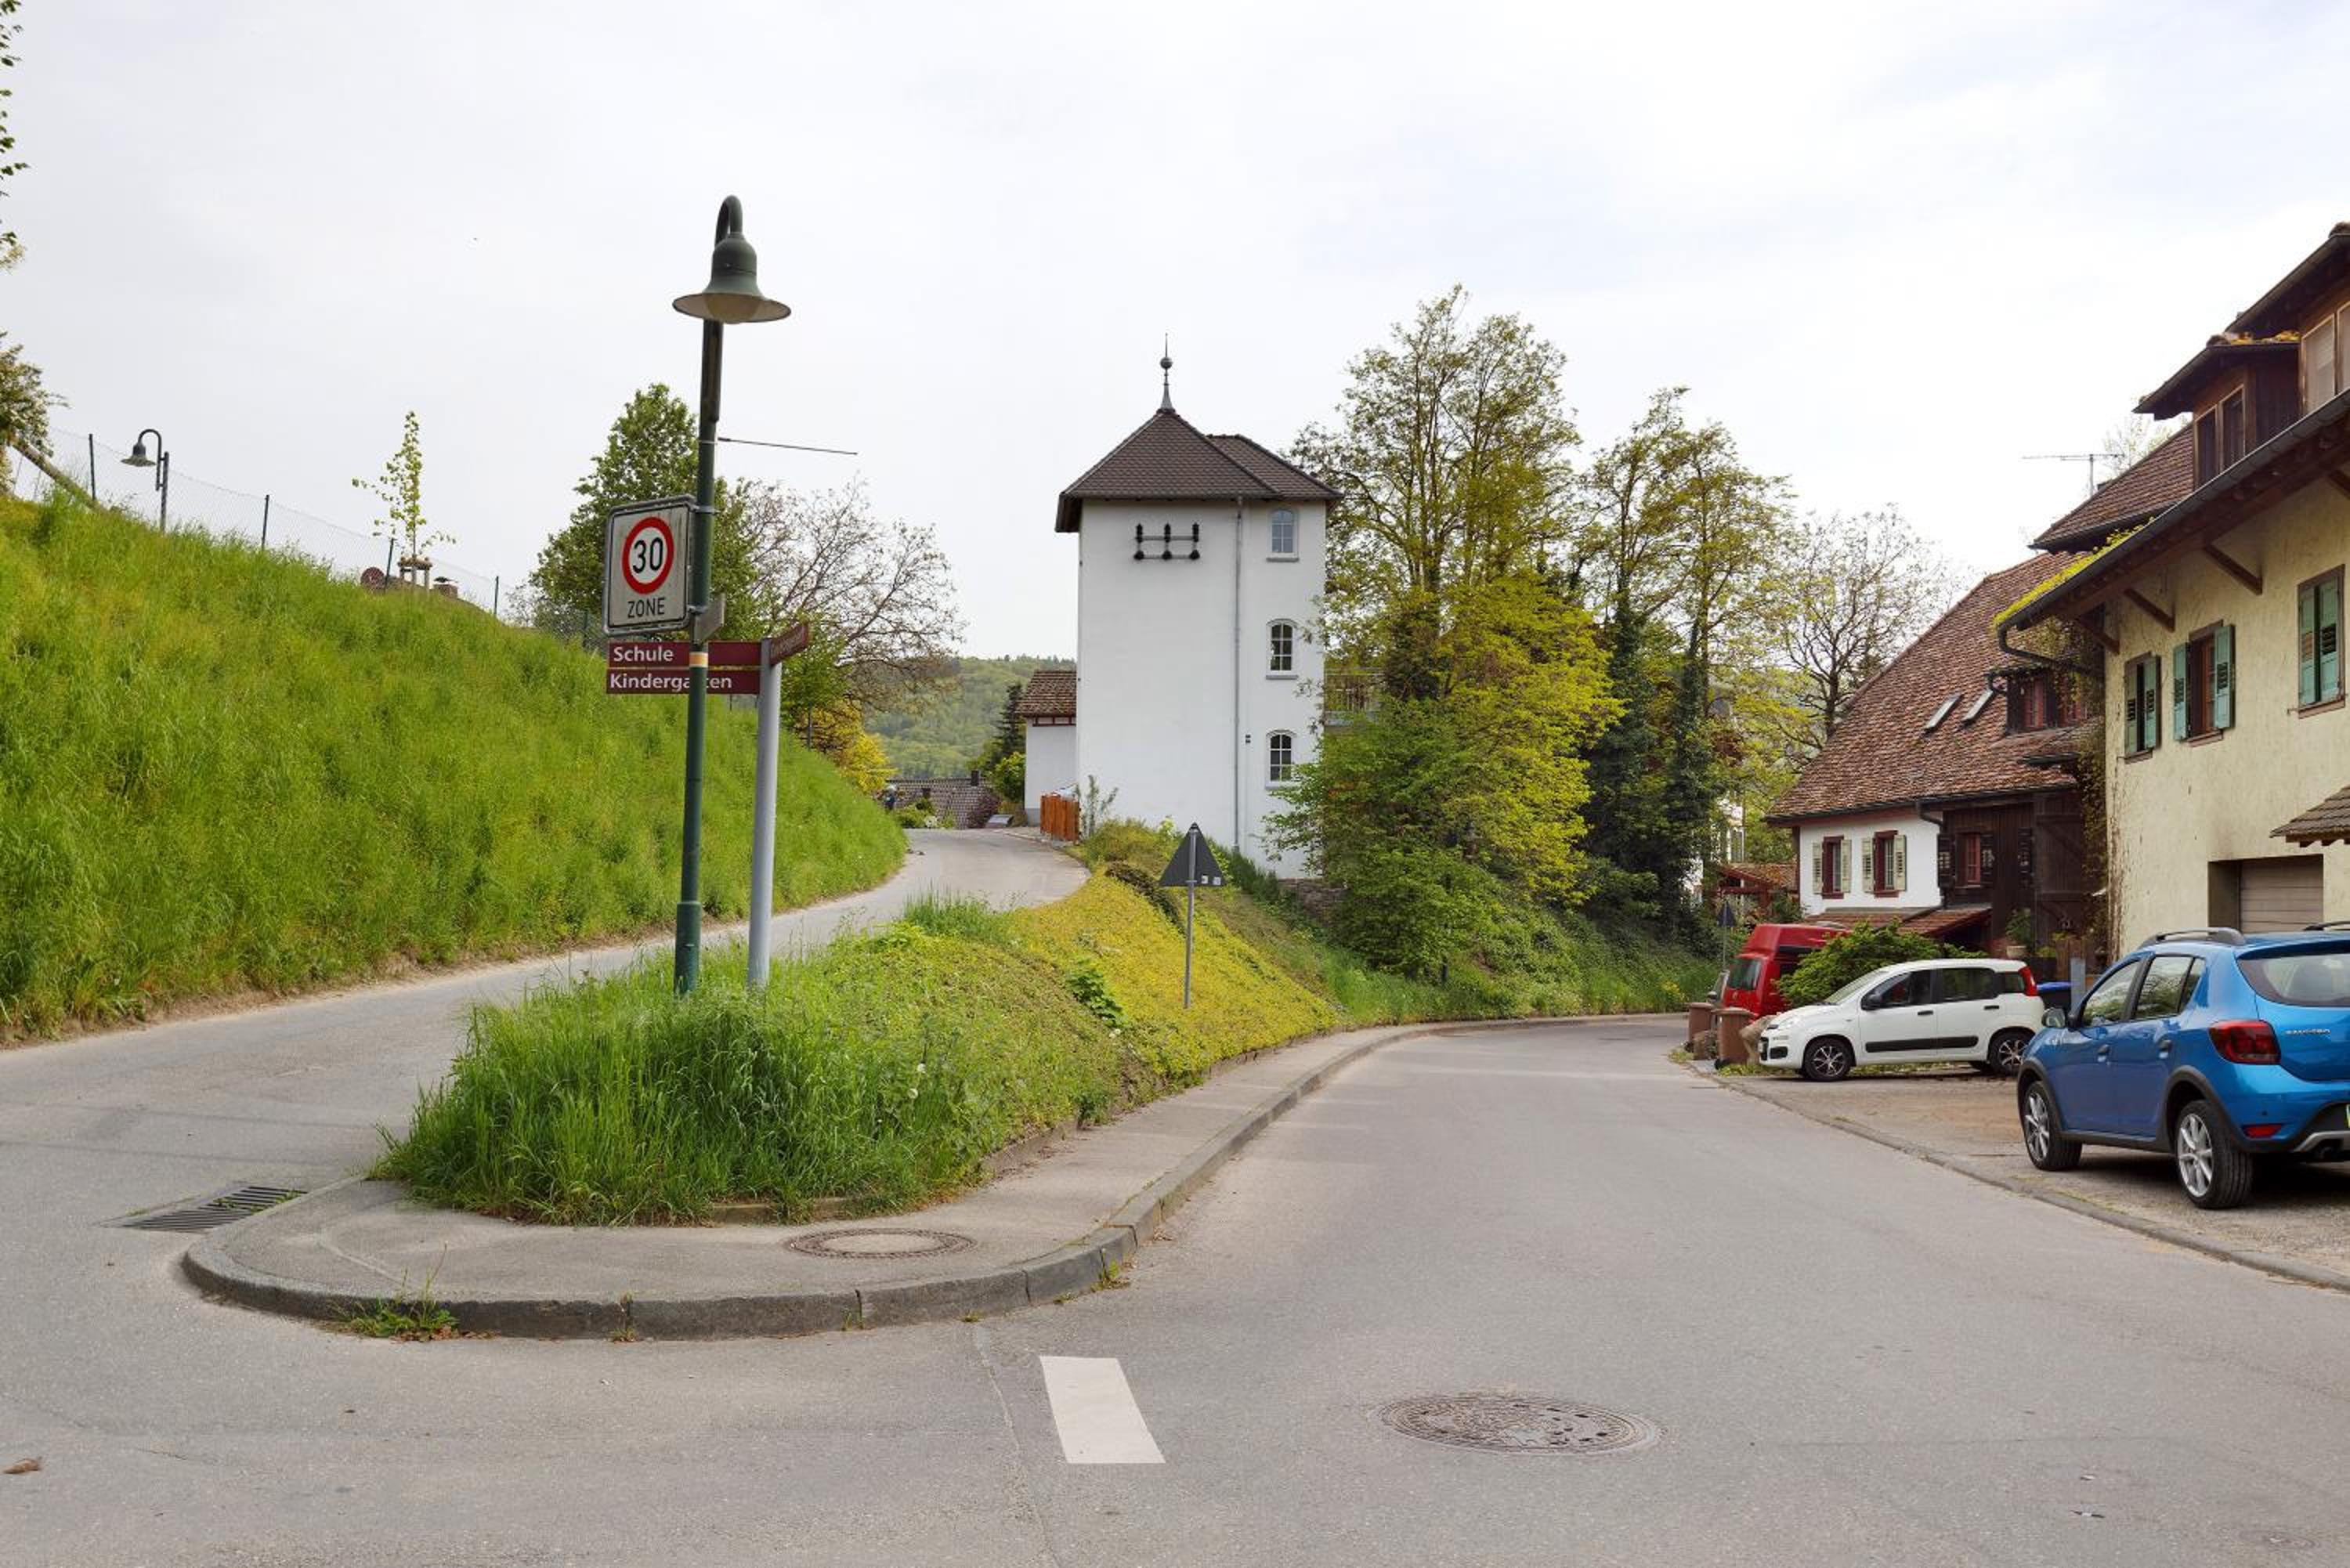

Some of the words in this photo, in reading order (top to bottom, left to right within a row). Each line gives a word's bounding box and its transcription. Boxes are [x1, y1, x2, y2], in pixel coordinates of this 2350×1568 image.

[633, 537, 663, 573] 30
[627, 597, 666, 619] ZONE
[613, 645, 674, 662] Schule
[610, 673, 732, 692] Kindergaen
